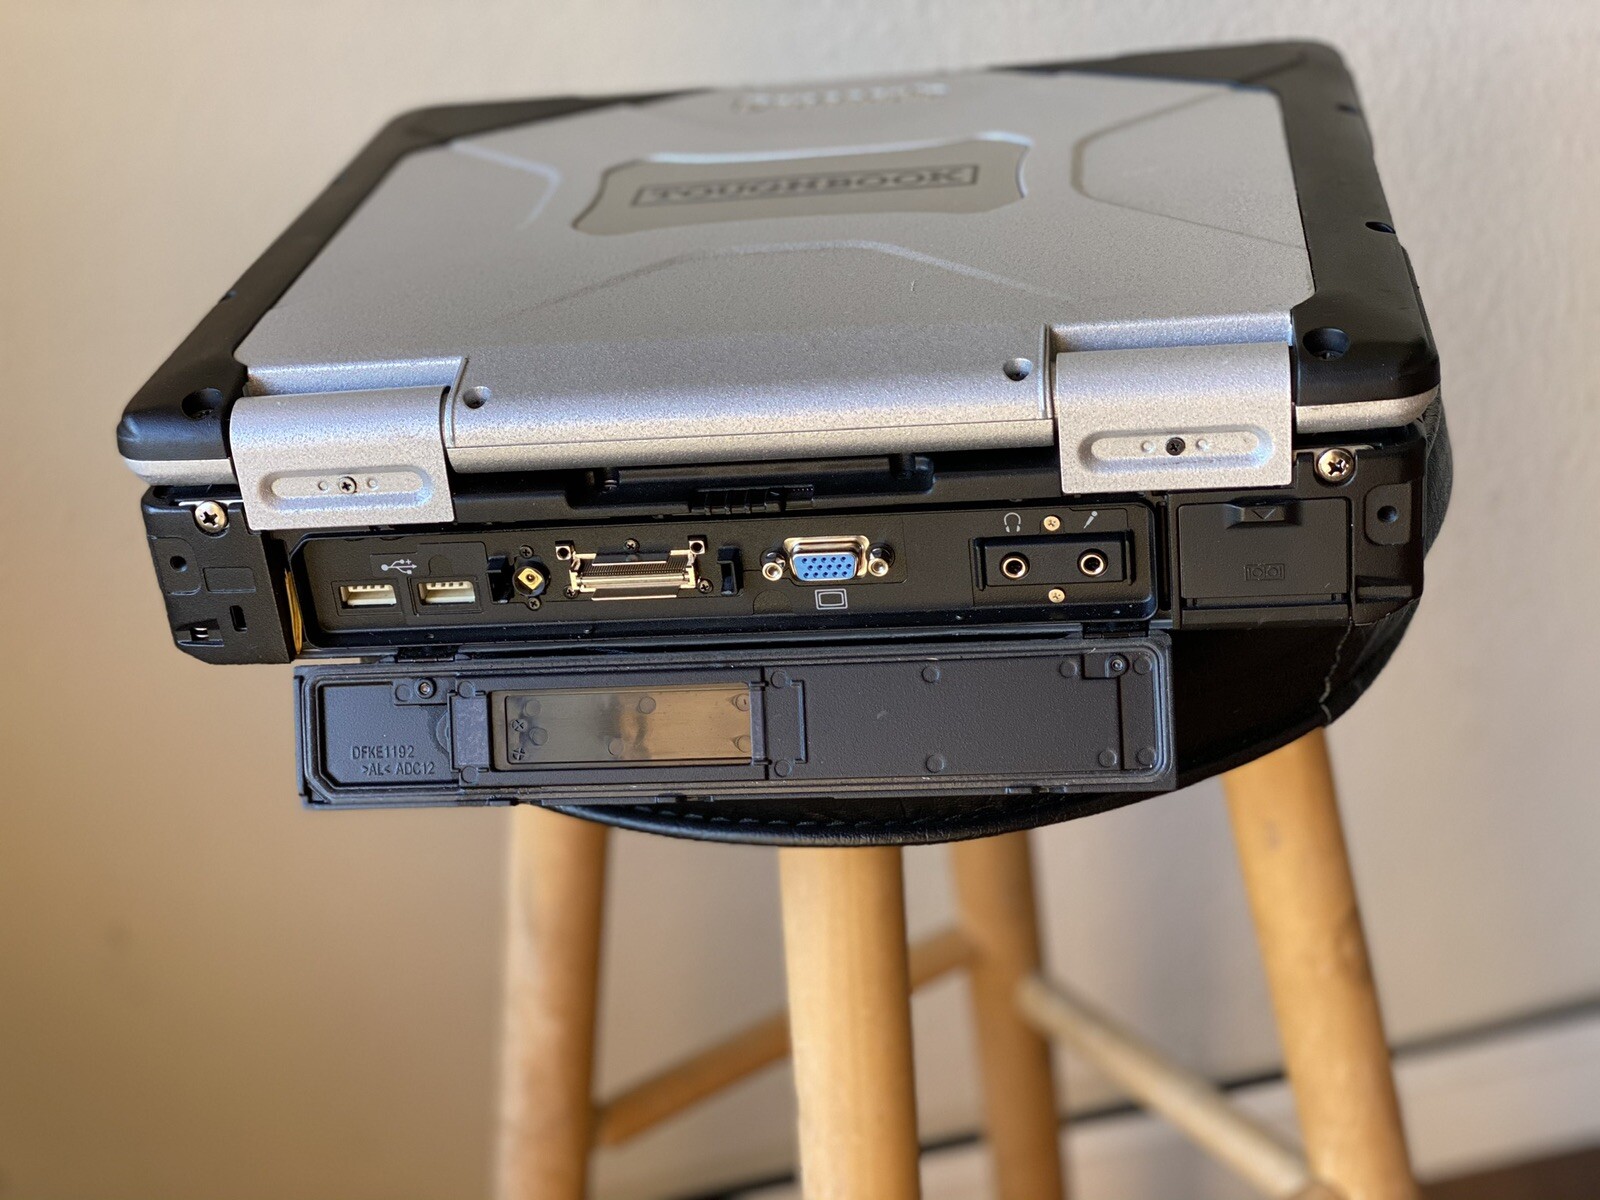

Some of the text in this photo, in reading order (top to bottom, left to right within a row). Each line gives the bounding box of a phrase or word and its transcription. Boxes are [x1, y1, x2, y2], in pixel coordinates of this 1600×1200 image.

[648, 168, 966, 199] TOUGHBOOK
[352, 745, 415, 759] DFKE1192
[395, 761, 435, 775] ADC12
